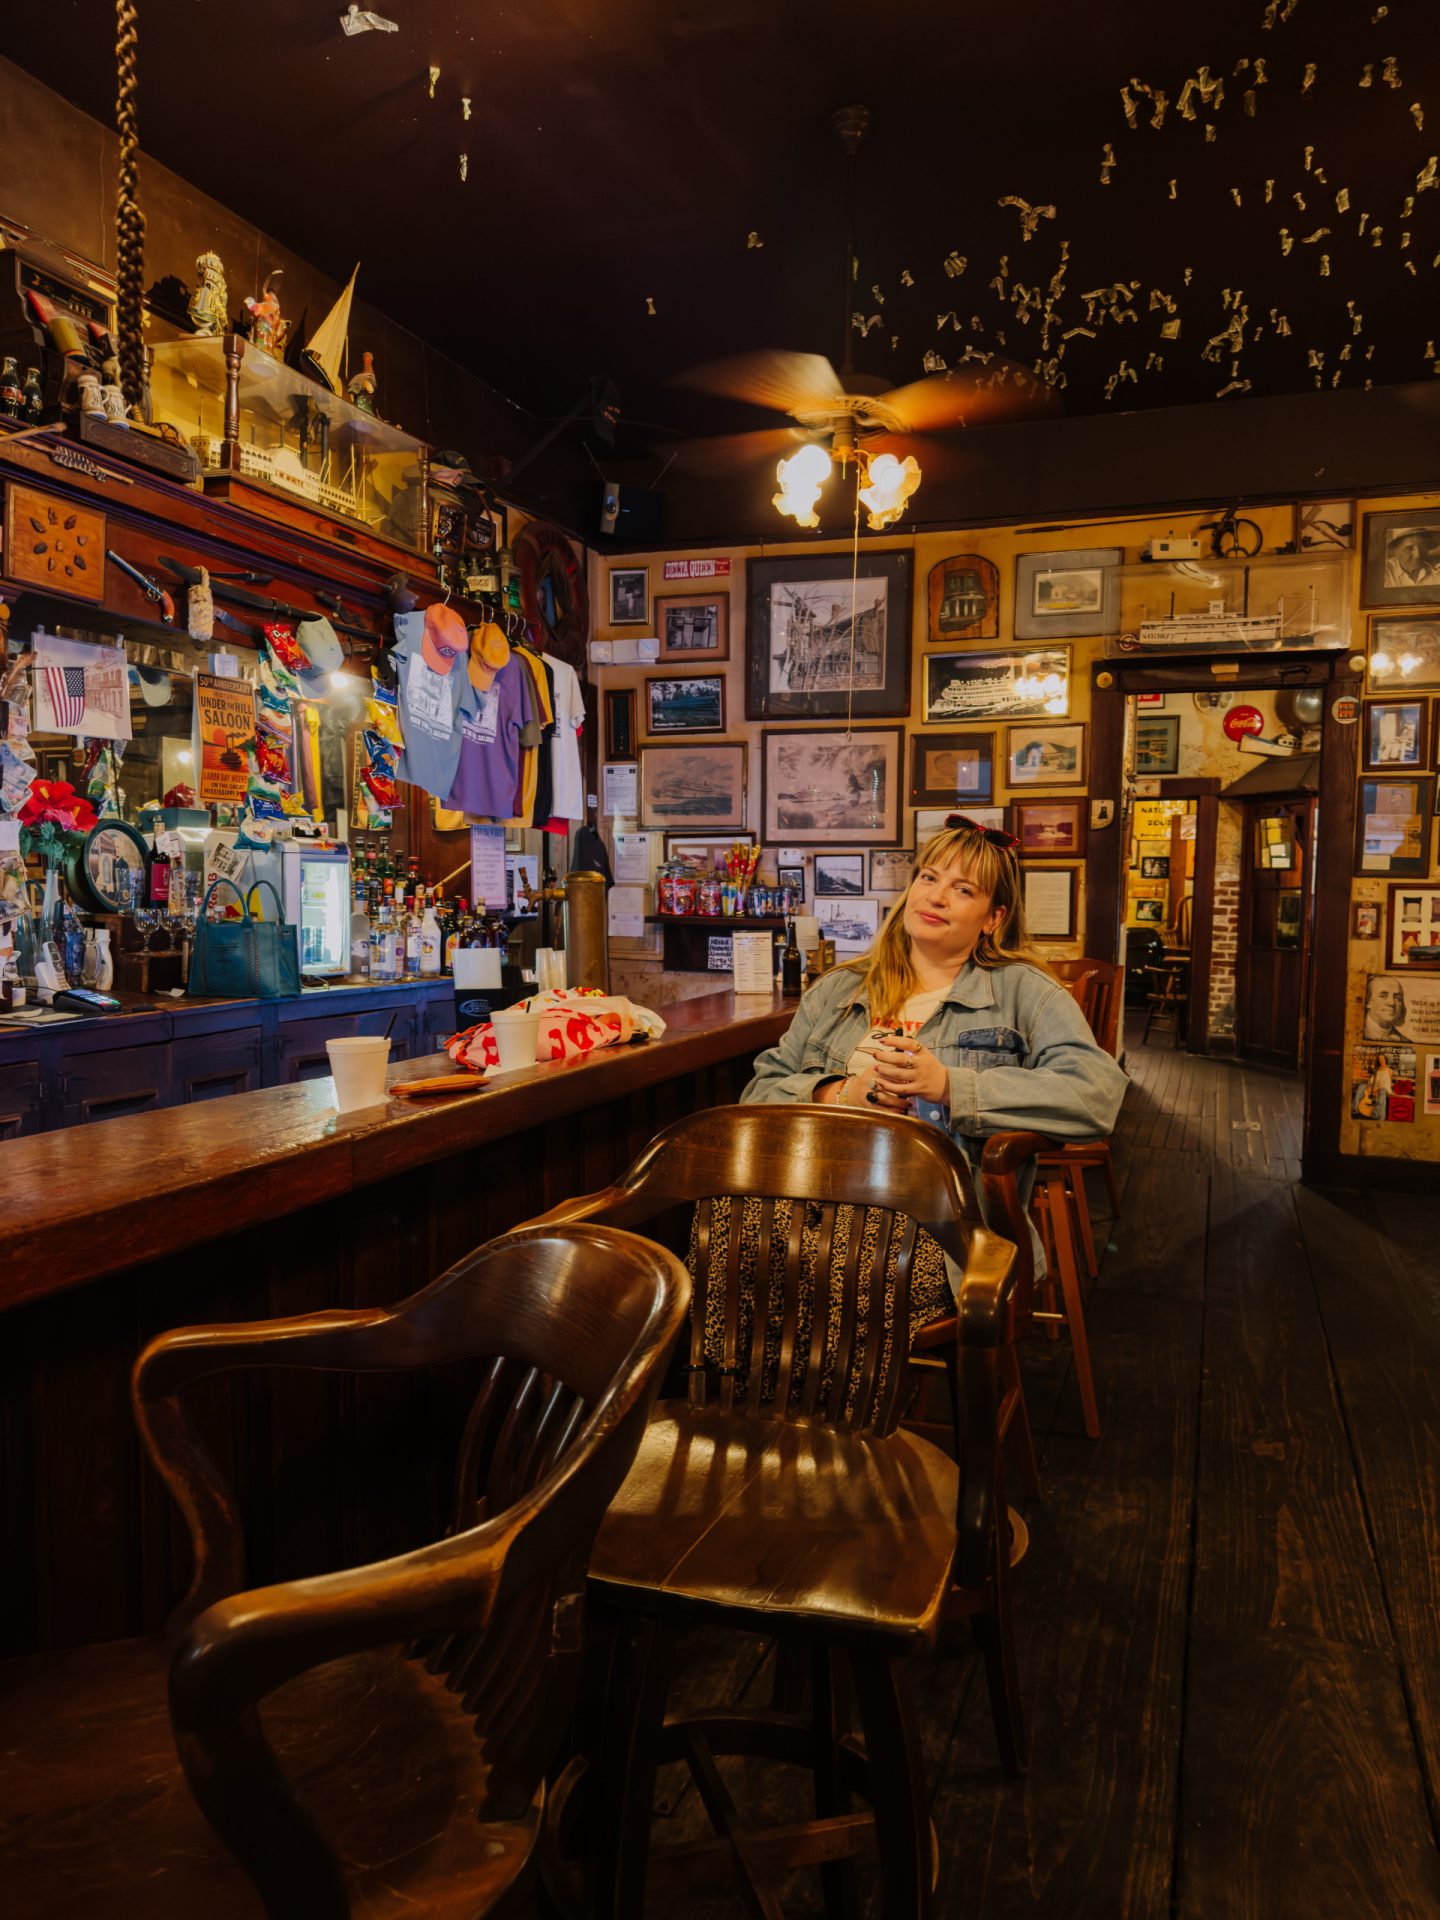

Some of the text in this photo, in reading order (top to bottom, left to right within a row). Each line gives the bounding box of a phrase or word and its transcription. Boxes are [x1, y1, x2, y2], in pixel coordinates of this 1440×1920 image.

[665, 561, 689, 578] DELTA
[690, 560, 715, 577] QUEEN
[200, 696, 227, 710] UNDER
[235, 702, 253, 715] HILL
[204, 709, 251, 730] SALOON
[203, 771, 220, 781] LABOR
[220, 772, 230, 781] DAY
[203, 788, 235, 796] MISSISSIPPI
